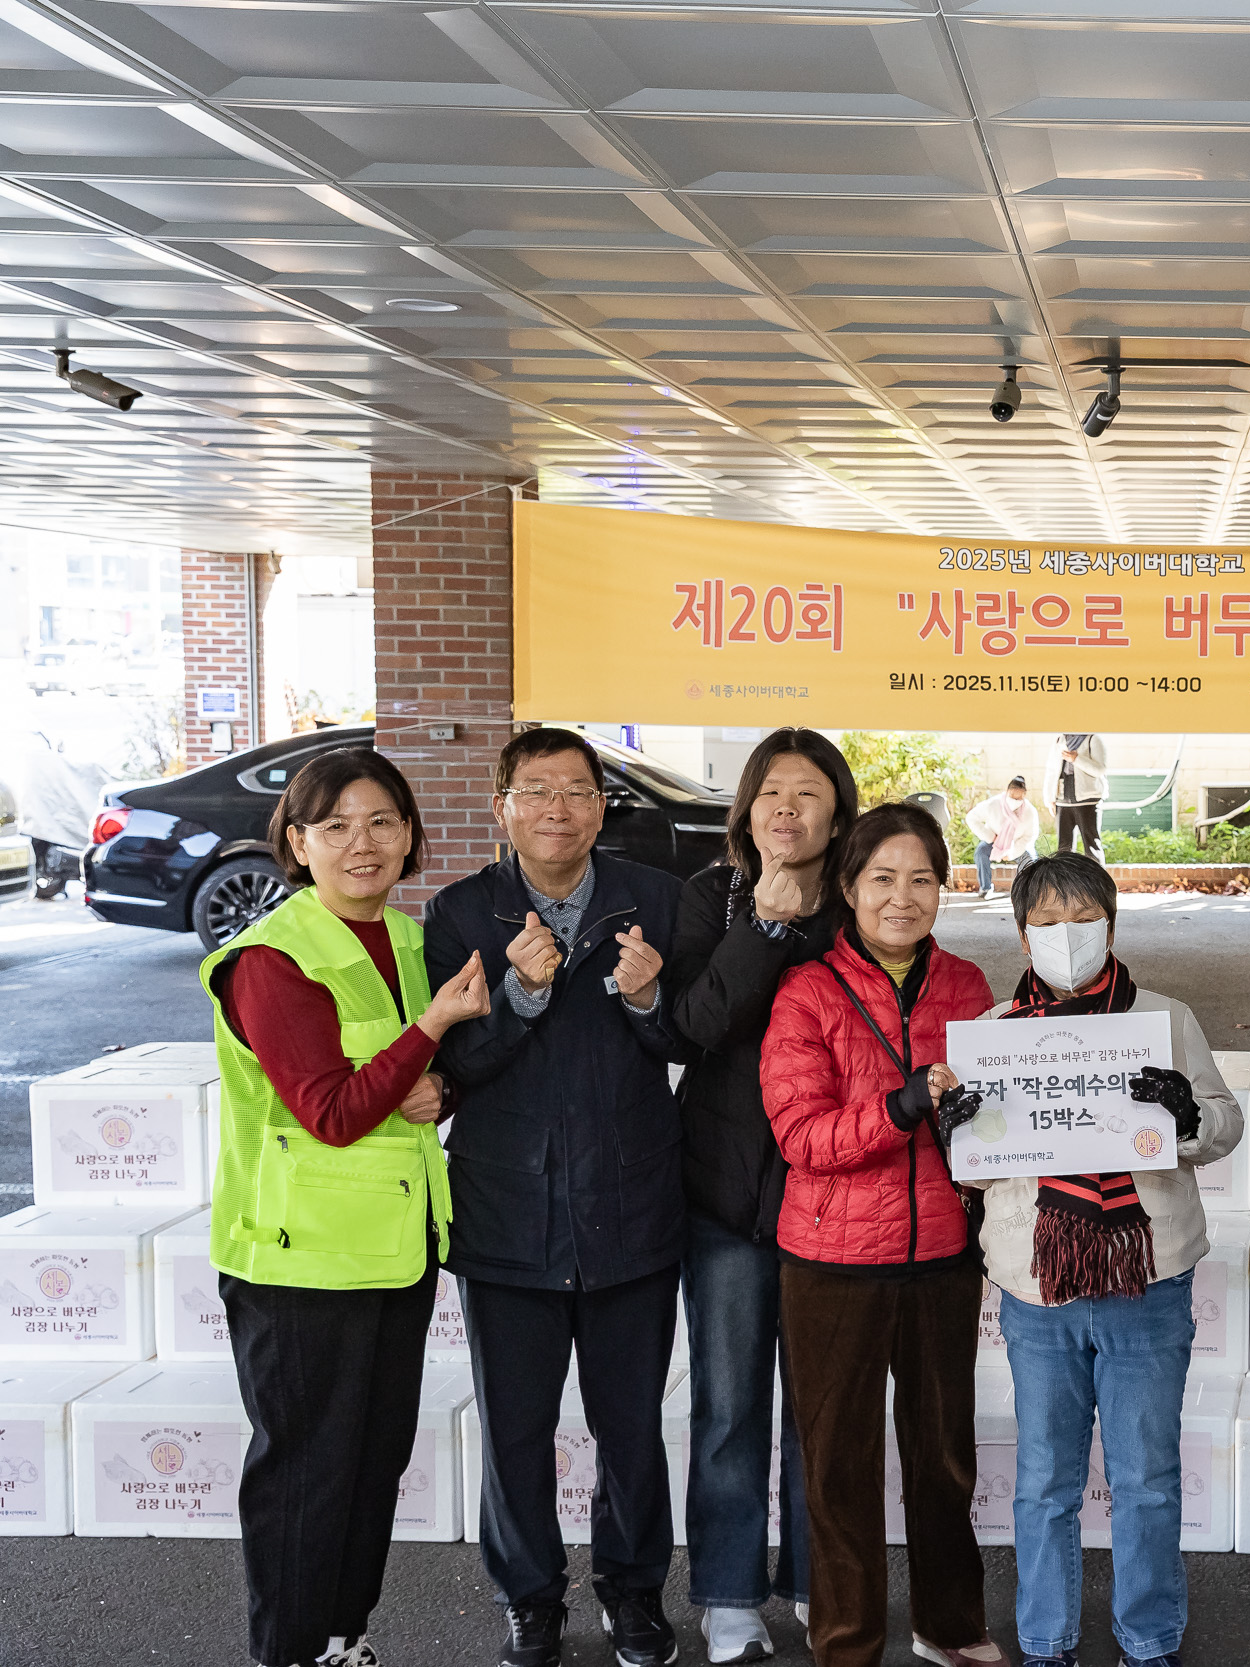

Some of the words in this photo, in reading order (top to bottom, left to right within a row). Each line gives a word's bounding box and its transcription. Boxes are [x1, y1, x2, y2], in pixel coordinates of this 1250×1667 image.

[938, 547, 1031, 574] 2025년
[1040, 550, 1245, 577] 세종사이버대학교
[671, 578, 843, 653] 제20회
[897, 588, 1131, 657] "사랑으로
[889, 672, 924, 691] 일시
[943, 675, 1070, 693] 2025.11.15(토)
[1078, 676, 1129, 692] 10:00
[1136, 676, 1201, 693] ~14:00
[709, 683, 809, 699] 세종사이버대학교
[976, 1055, 1011, 1068] 제20회
[1014, 1053, 1059, 1066] "사랑으로
[1061, 1050, 1096, 1063] 버무린"
[1098, 1049, 1118, 1062] 김장
[1121, 1047, 1151, 1060] 나누기
[1013, 1072, 1141, 1100] "작은예수의
[1028, 1107, 1096, 1131] 15박스
[984, 1152, 1054, 1165] 세종사이버대학교
[11, 1306, 57, 1317] 사랑으로
[62, 1307, 98, 1318] 버무린
[439, 1312, 462, 1322] 버무
[24, 1322, 48, 1333] 김장
[53, 1322, 87, 1332] 나누기
[121, 1482, 170, 1494] 사랑으로
[175, 1483, 212, 1494] 버무린
[136, 1499, 160, 1510] 김장
[165, 1499, 202, 1510] 나누기
